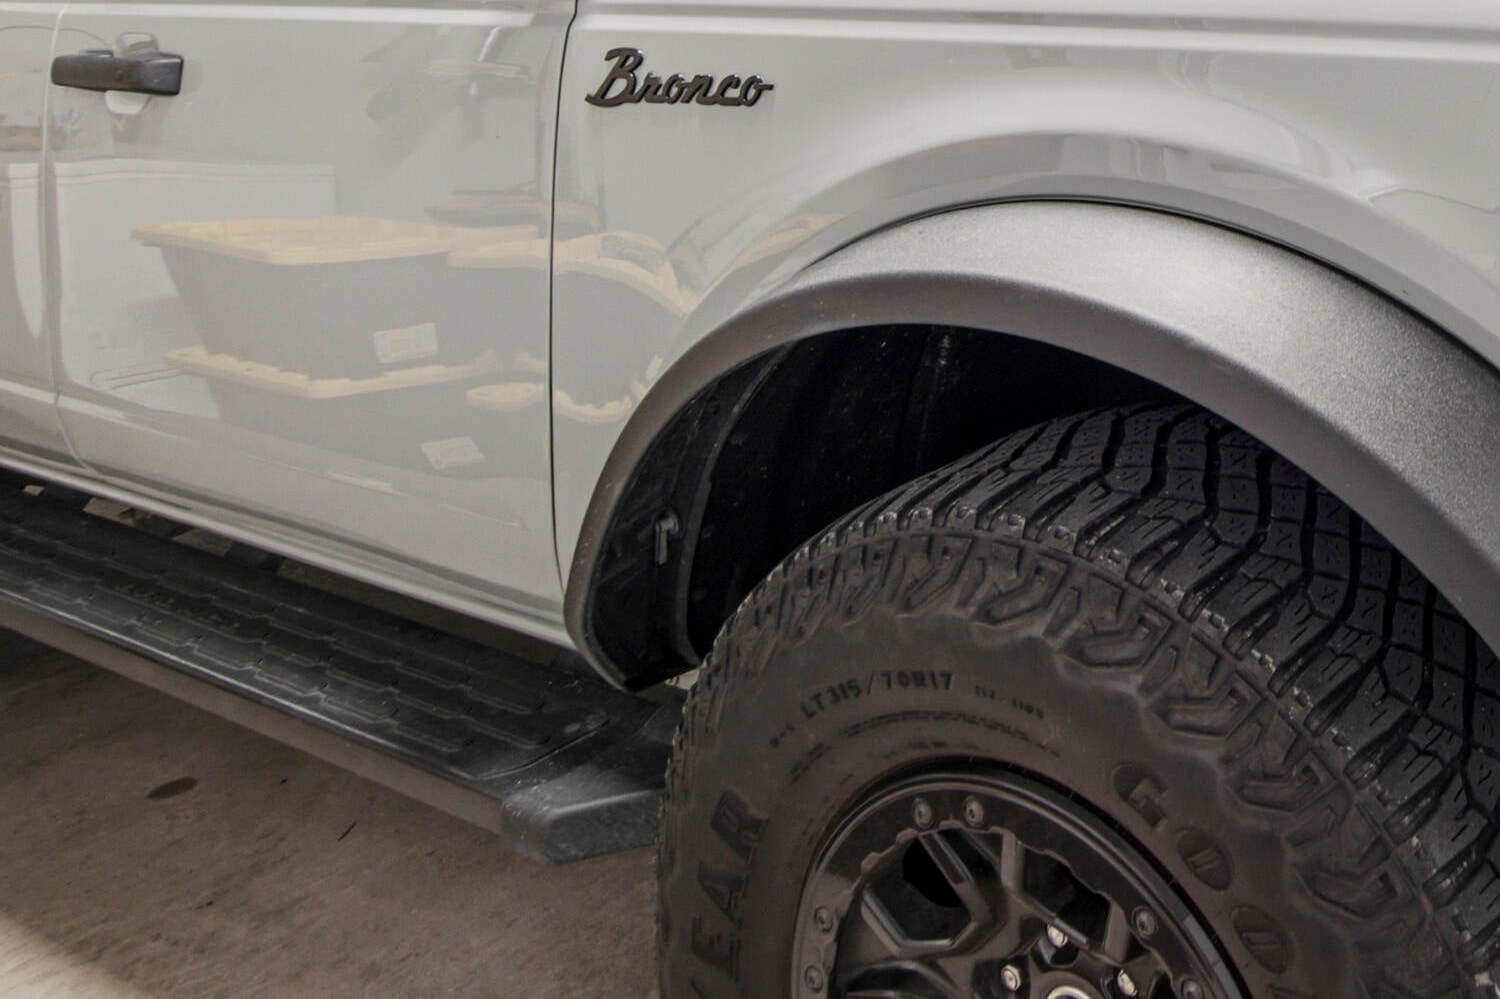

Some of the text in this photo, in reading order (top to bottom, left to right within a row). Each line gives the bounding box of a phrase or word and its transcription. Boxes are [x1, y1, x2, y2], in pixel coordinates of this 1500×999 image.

[585, 47, 775, 108] Bronco
[801, 670, 954, 719] LT315/70R17
[1111, 761, 1312, 999] GOO
